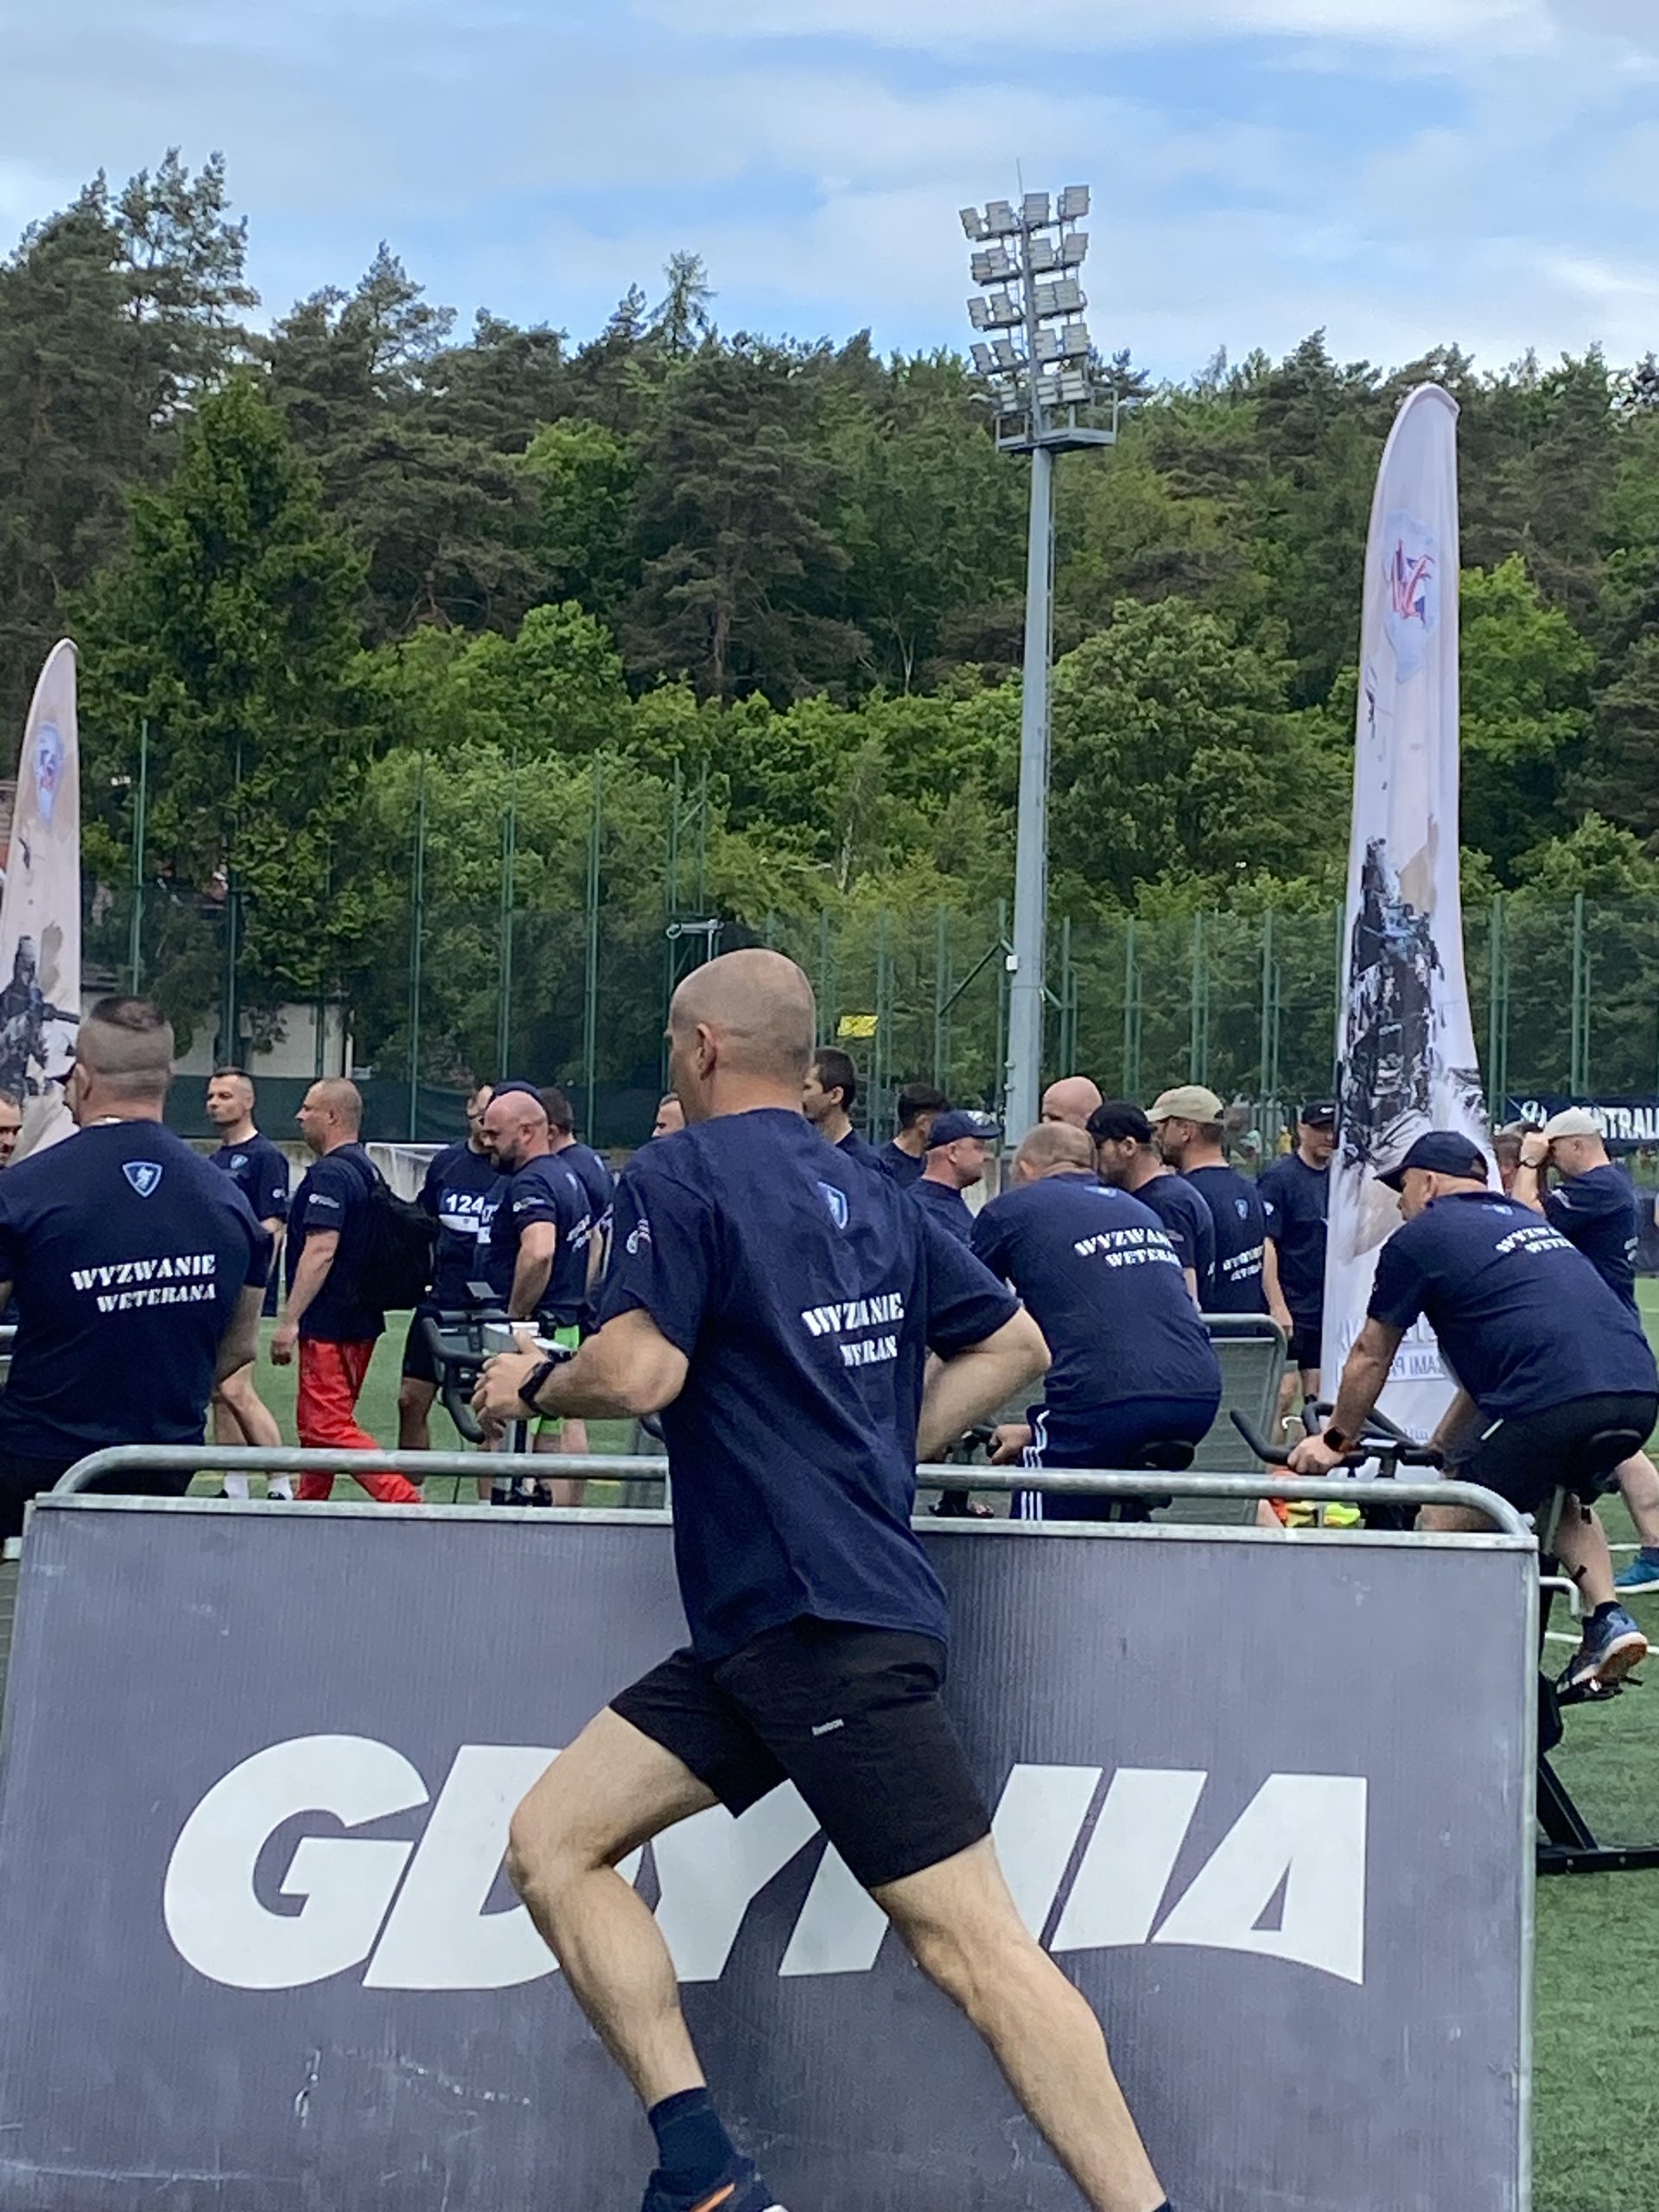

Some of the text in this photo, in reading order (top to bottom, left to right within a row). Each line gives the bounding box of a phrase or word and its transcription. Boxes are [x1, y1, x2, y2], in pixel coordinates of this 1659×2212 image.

[445, 1193, 485, 1214] 124
[70, 1254, 216, 1291] WYZWANIE
[96, 1283, 216, 1313] WETERANA
